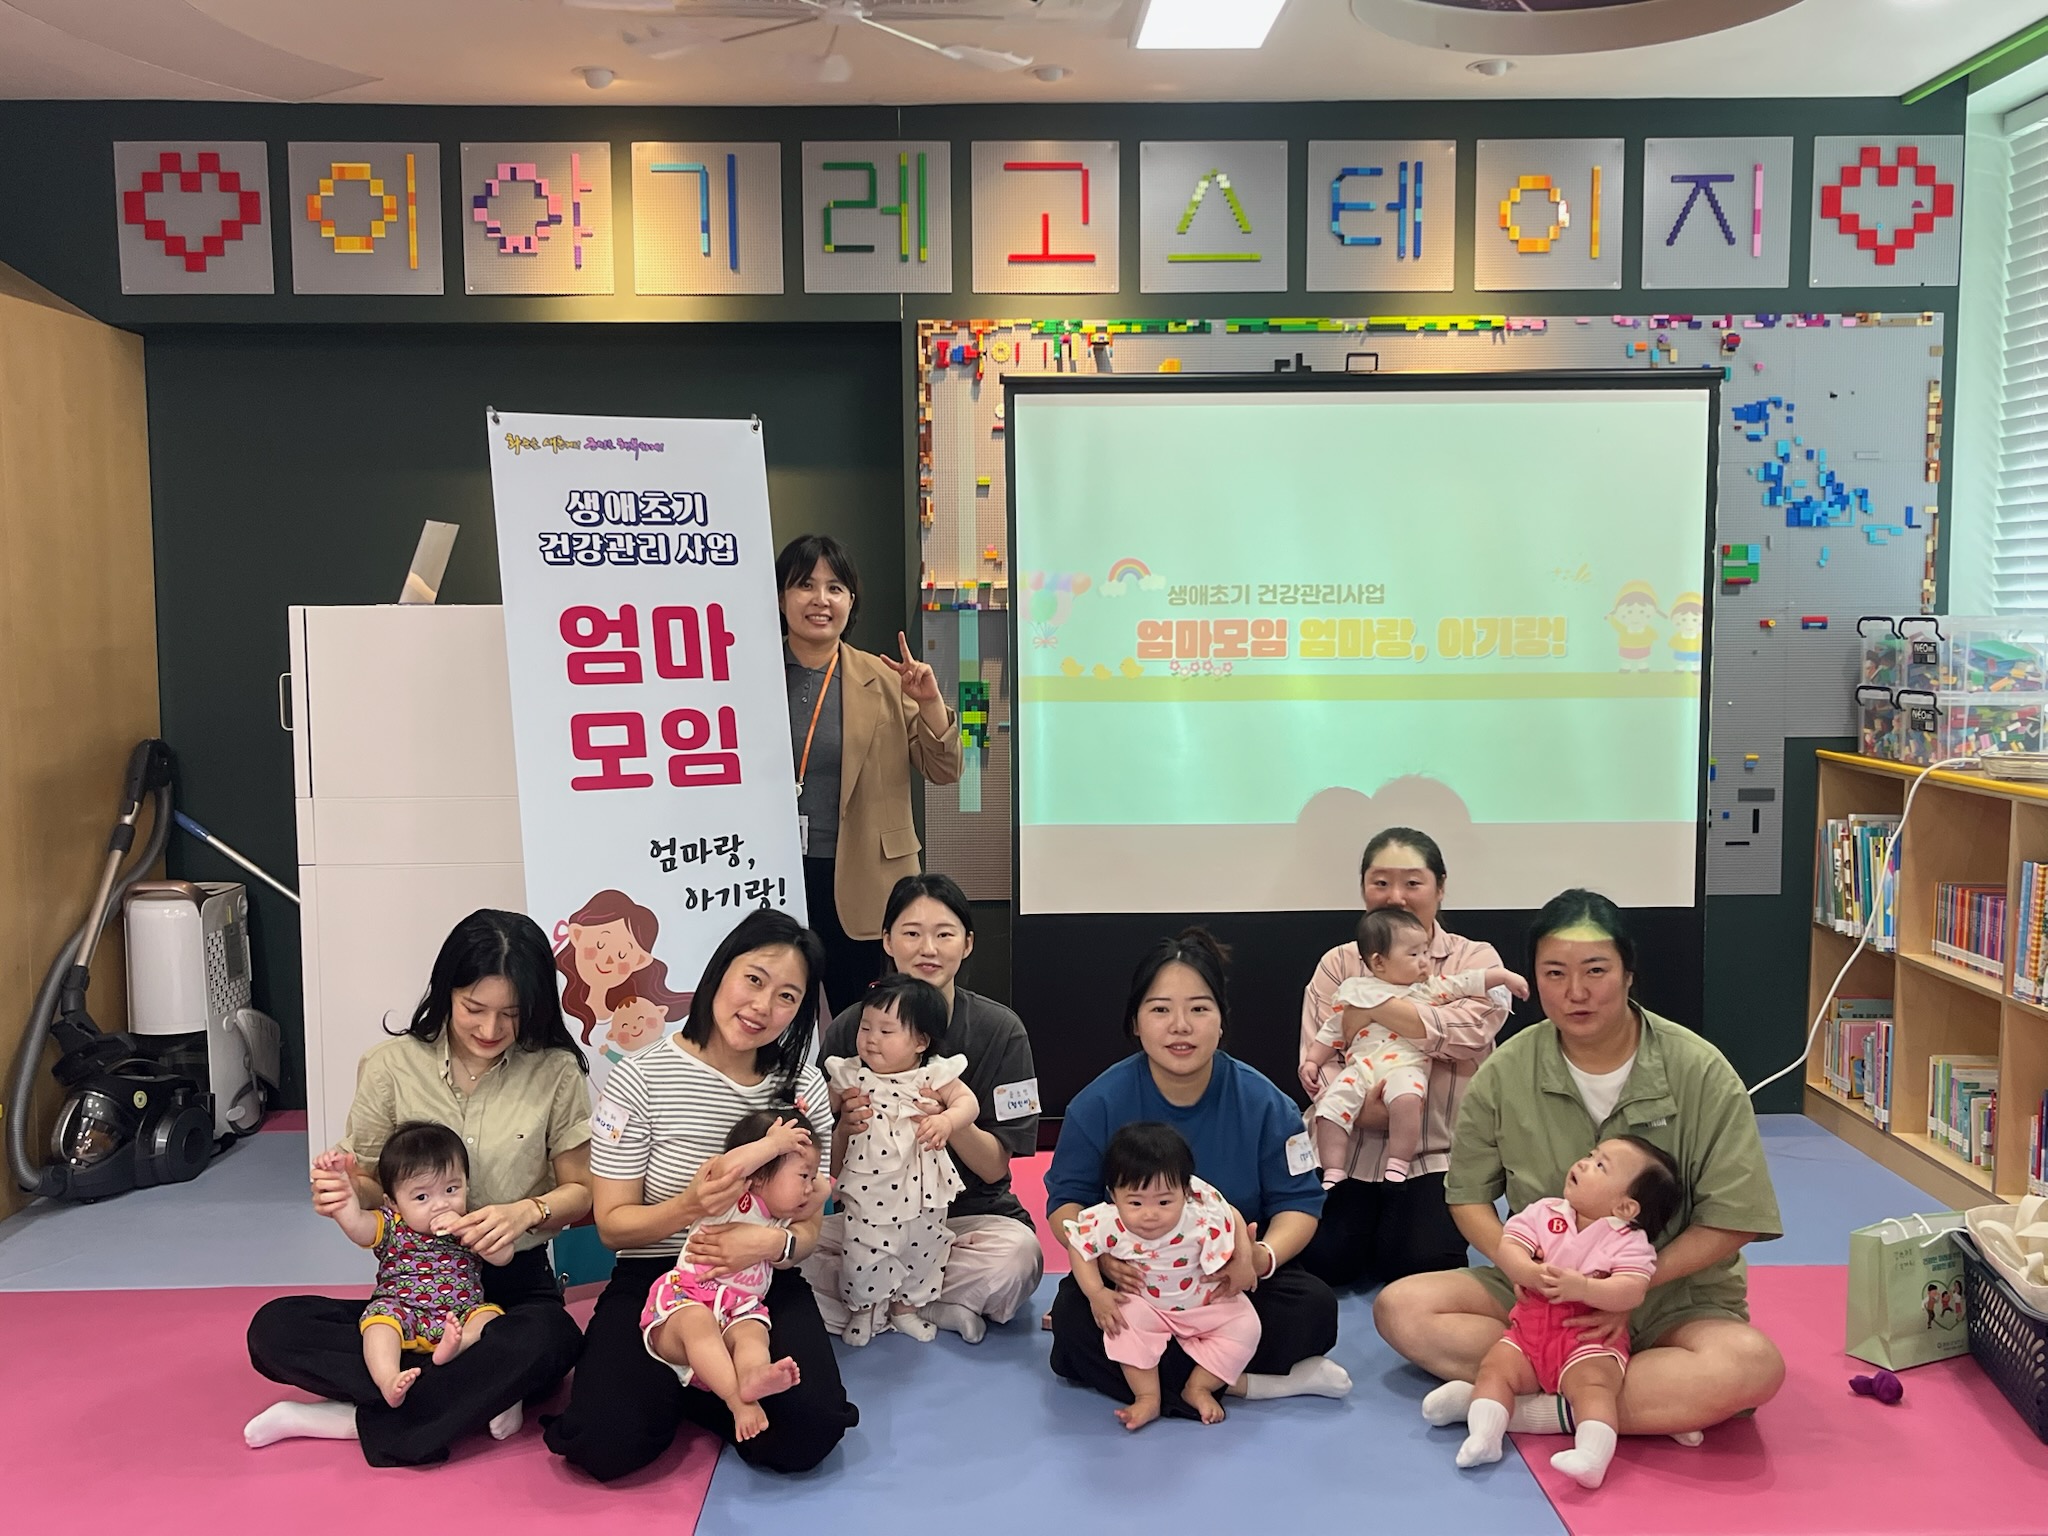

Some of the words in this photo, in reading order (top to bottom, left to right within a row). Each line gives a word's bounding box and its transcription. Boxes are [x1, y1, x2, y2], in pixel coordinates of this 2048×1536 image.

[565, 490, 708, 526] 생애초기
[539, 532, 671, 566] 건강관리
[675, 533, 738, 565] 사업
[1168, 584, 1250, 606] 생애초기
[1258, 584, 1385, 605] 건강관리사업
[559, 602, 735, 685] 엄마
[1137, 618, 1288, 660] 엄마모임
[1299, 617, 1427, 662] 엄마랑,
[1438, 616, 1567, 658] 아기랑!
[570, 705, 742, 791] 모임
[650, 833, 755, 873] 엄마랑,
[685, 877, 786, 912] 아기랑!
